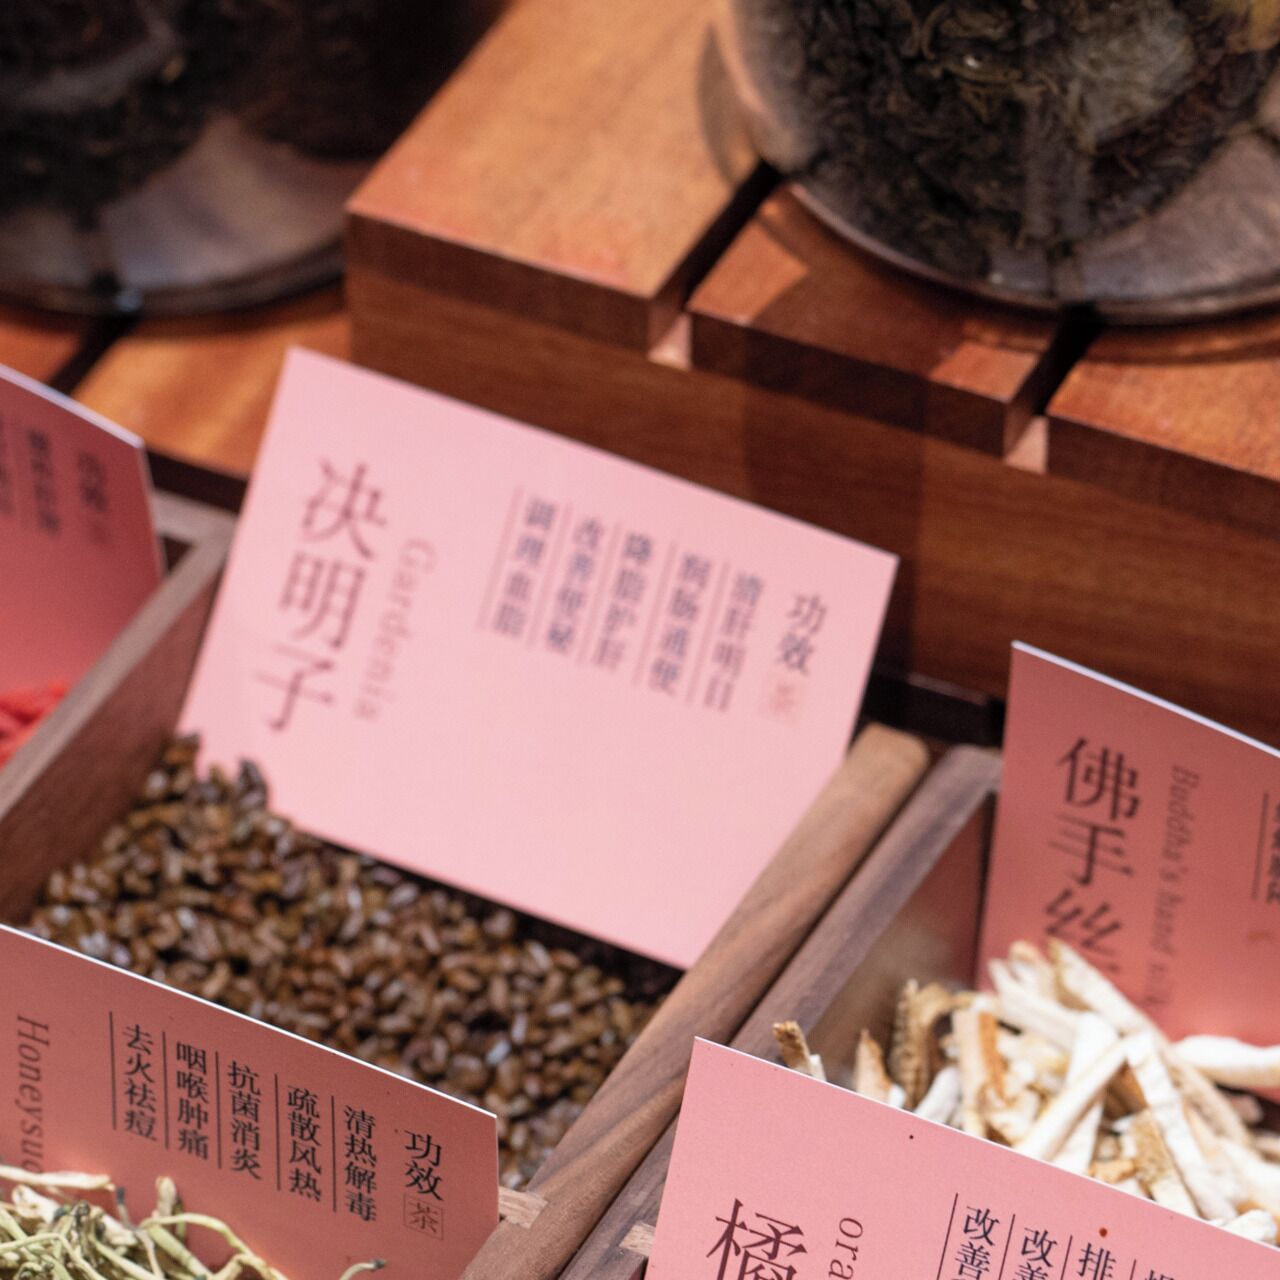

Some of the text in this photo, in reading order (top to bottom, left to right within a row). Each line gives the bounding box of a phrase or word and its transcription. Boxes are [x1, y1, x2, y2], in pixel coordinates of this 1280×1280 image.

[254, 458, 388, 732] 决明子
[780, 591, 830, 678] 功效
[120, 1022, 158, 1142] 去火祛痘
[174, 1040, 210, 1161] 咽喉肿痛
[226, 1059, 263, 1181] 抗菌消炎
[285, 1083, 323, 1203] 疏散风热
[342, 1104, 378, 1224] 清热解毒
[403, 1130, 445, 1202] 功效
